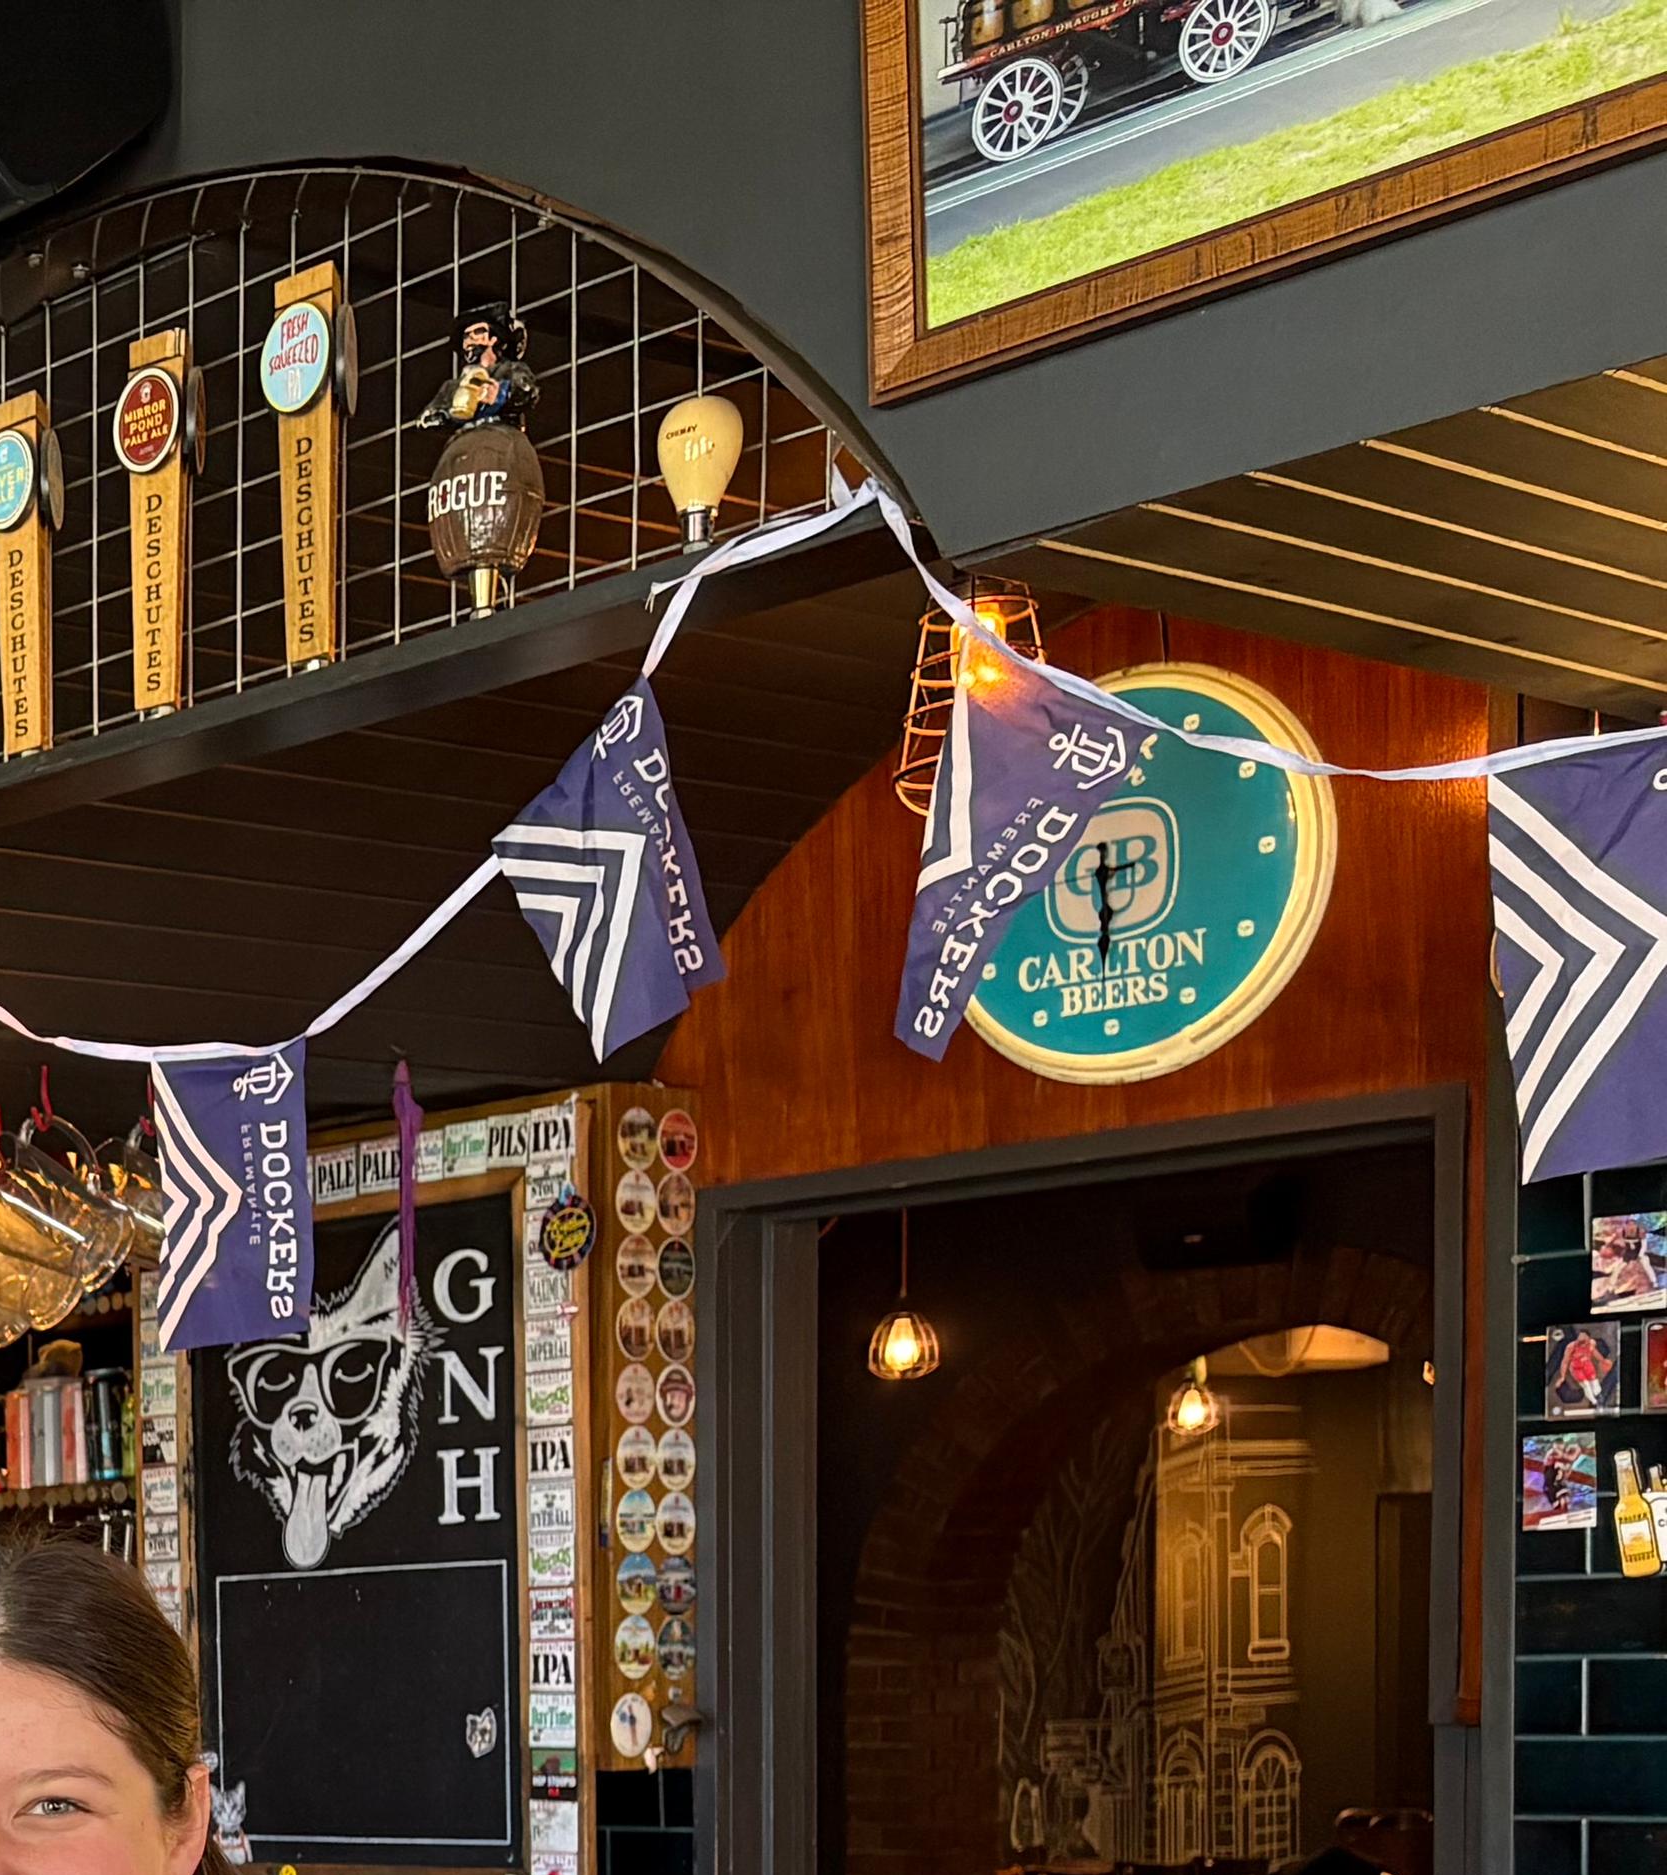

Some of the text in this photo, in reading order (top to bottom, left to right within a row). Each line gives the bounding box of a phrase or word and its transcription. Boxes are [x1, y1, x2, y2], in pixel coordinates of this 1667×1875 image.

[989, 5, 1120, 58] CARLTON DRAUGHT
[280, 311, 309, 342] FRESH
[268, 333, 318, 376] SQUEEZED
[124, 399, 166, 422] MIRROR
[129, 415, 163, 435] POND
[124, 424, 168, 448] PALE ALE
[428, 471, 507, 523] ROGUE
[296, 437, 315, 643] DESCHUTES
[145, 493, 162, 695] DESCHUTES
[8, 549, 29, 738] DESCHUTES
[1019, 927, 1207, 993] CARLTON
[1060, 973, 1169, 1018] BEERS
[487, 1119, 527, 1158] PILS
[532, 1116, 571, 1152] IPA
[317, 1158, 354, 1194] PALE
[361, 1149, 401, 1184] PALE
[530, 1439, 571, 1473] IPA
[532, 1653, 572, 1684] IPA
